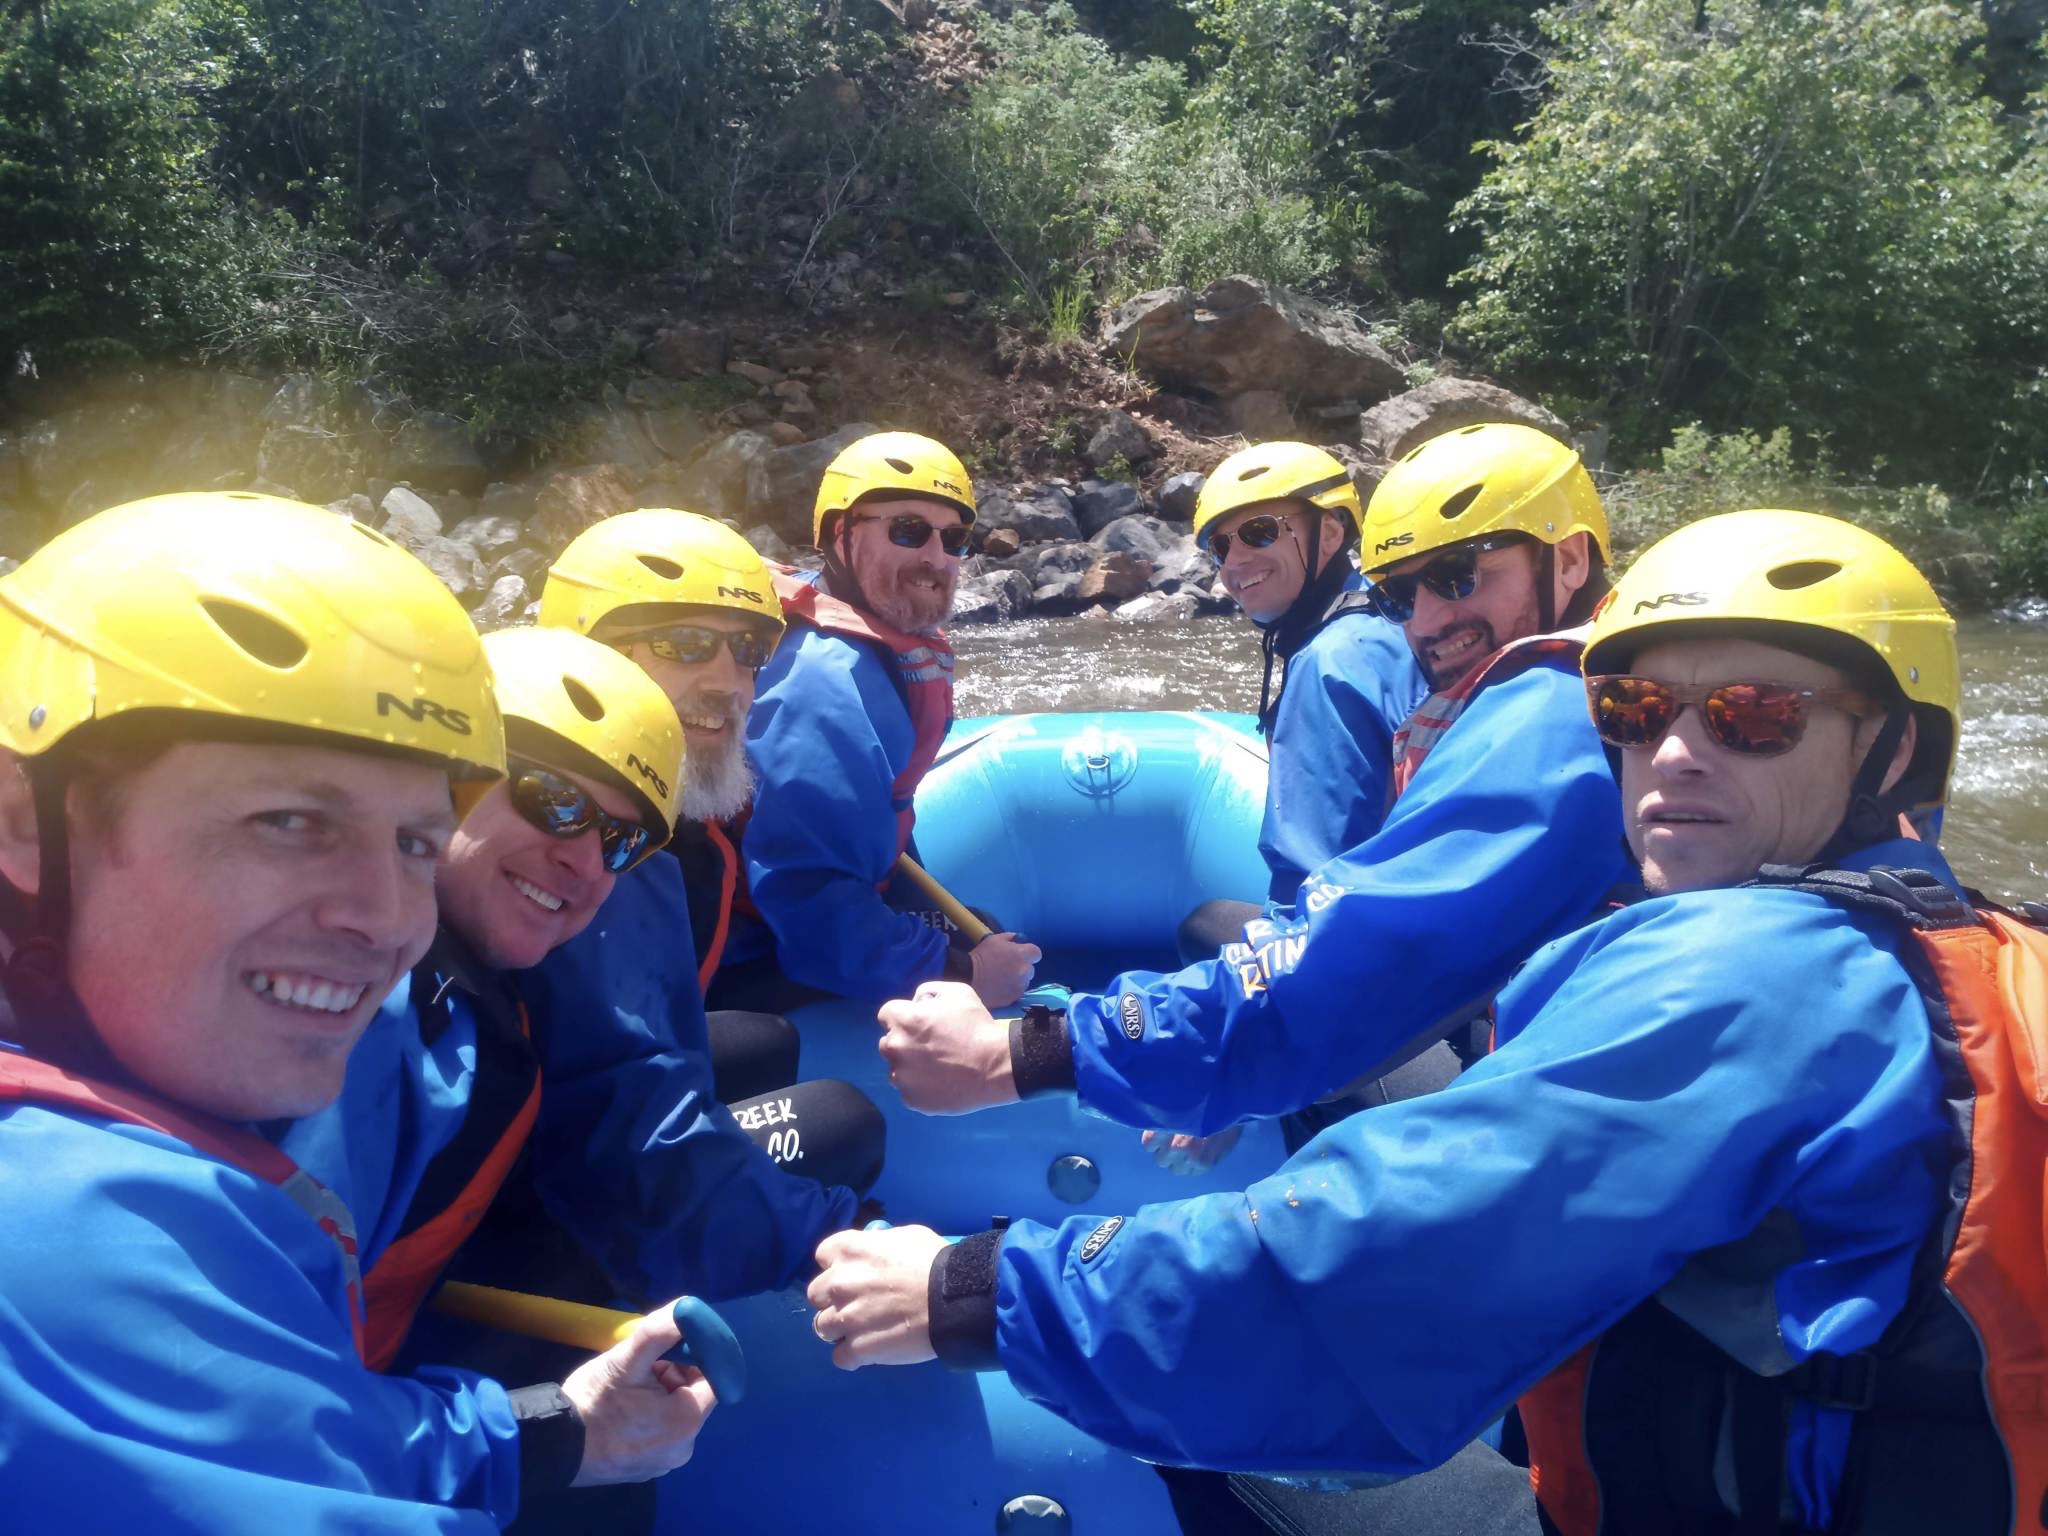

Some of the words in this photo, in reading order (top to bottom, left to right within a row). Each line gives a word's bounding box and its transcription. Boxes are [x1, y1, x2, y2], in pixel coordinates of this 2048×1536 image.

[933, 480, 962, 495] NRS
[1376, 532, 1414, 555] NRS
[718, 586, 763, 604] NRS
[1633, 592, 1709, 615] NRS
[377, 692, 472, 735] NRS
[627, 753, 668, 799] NRS
